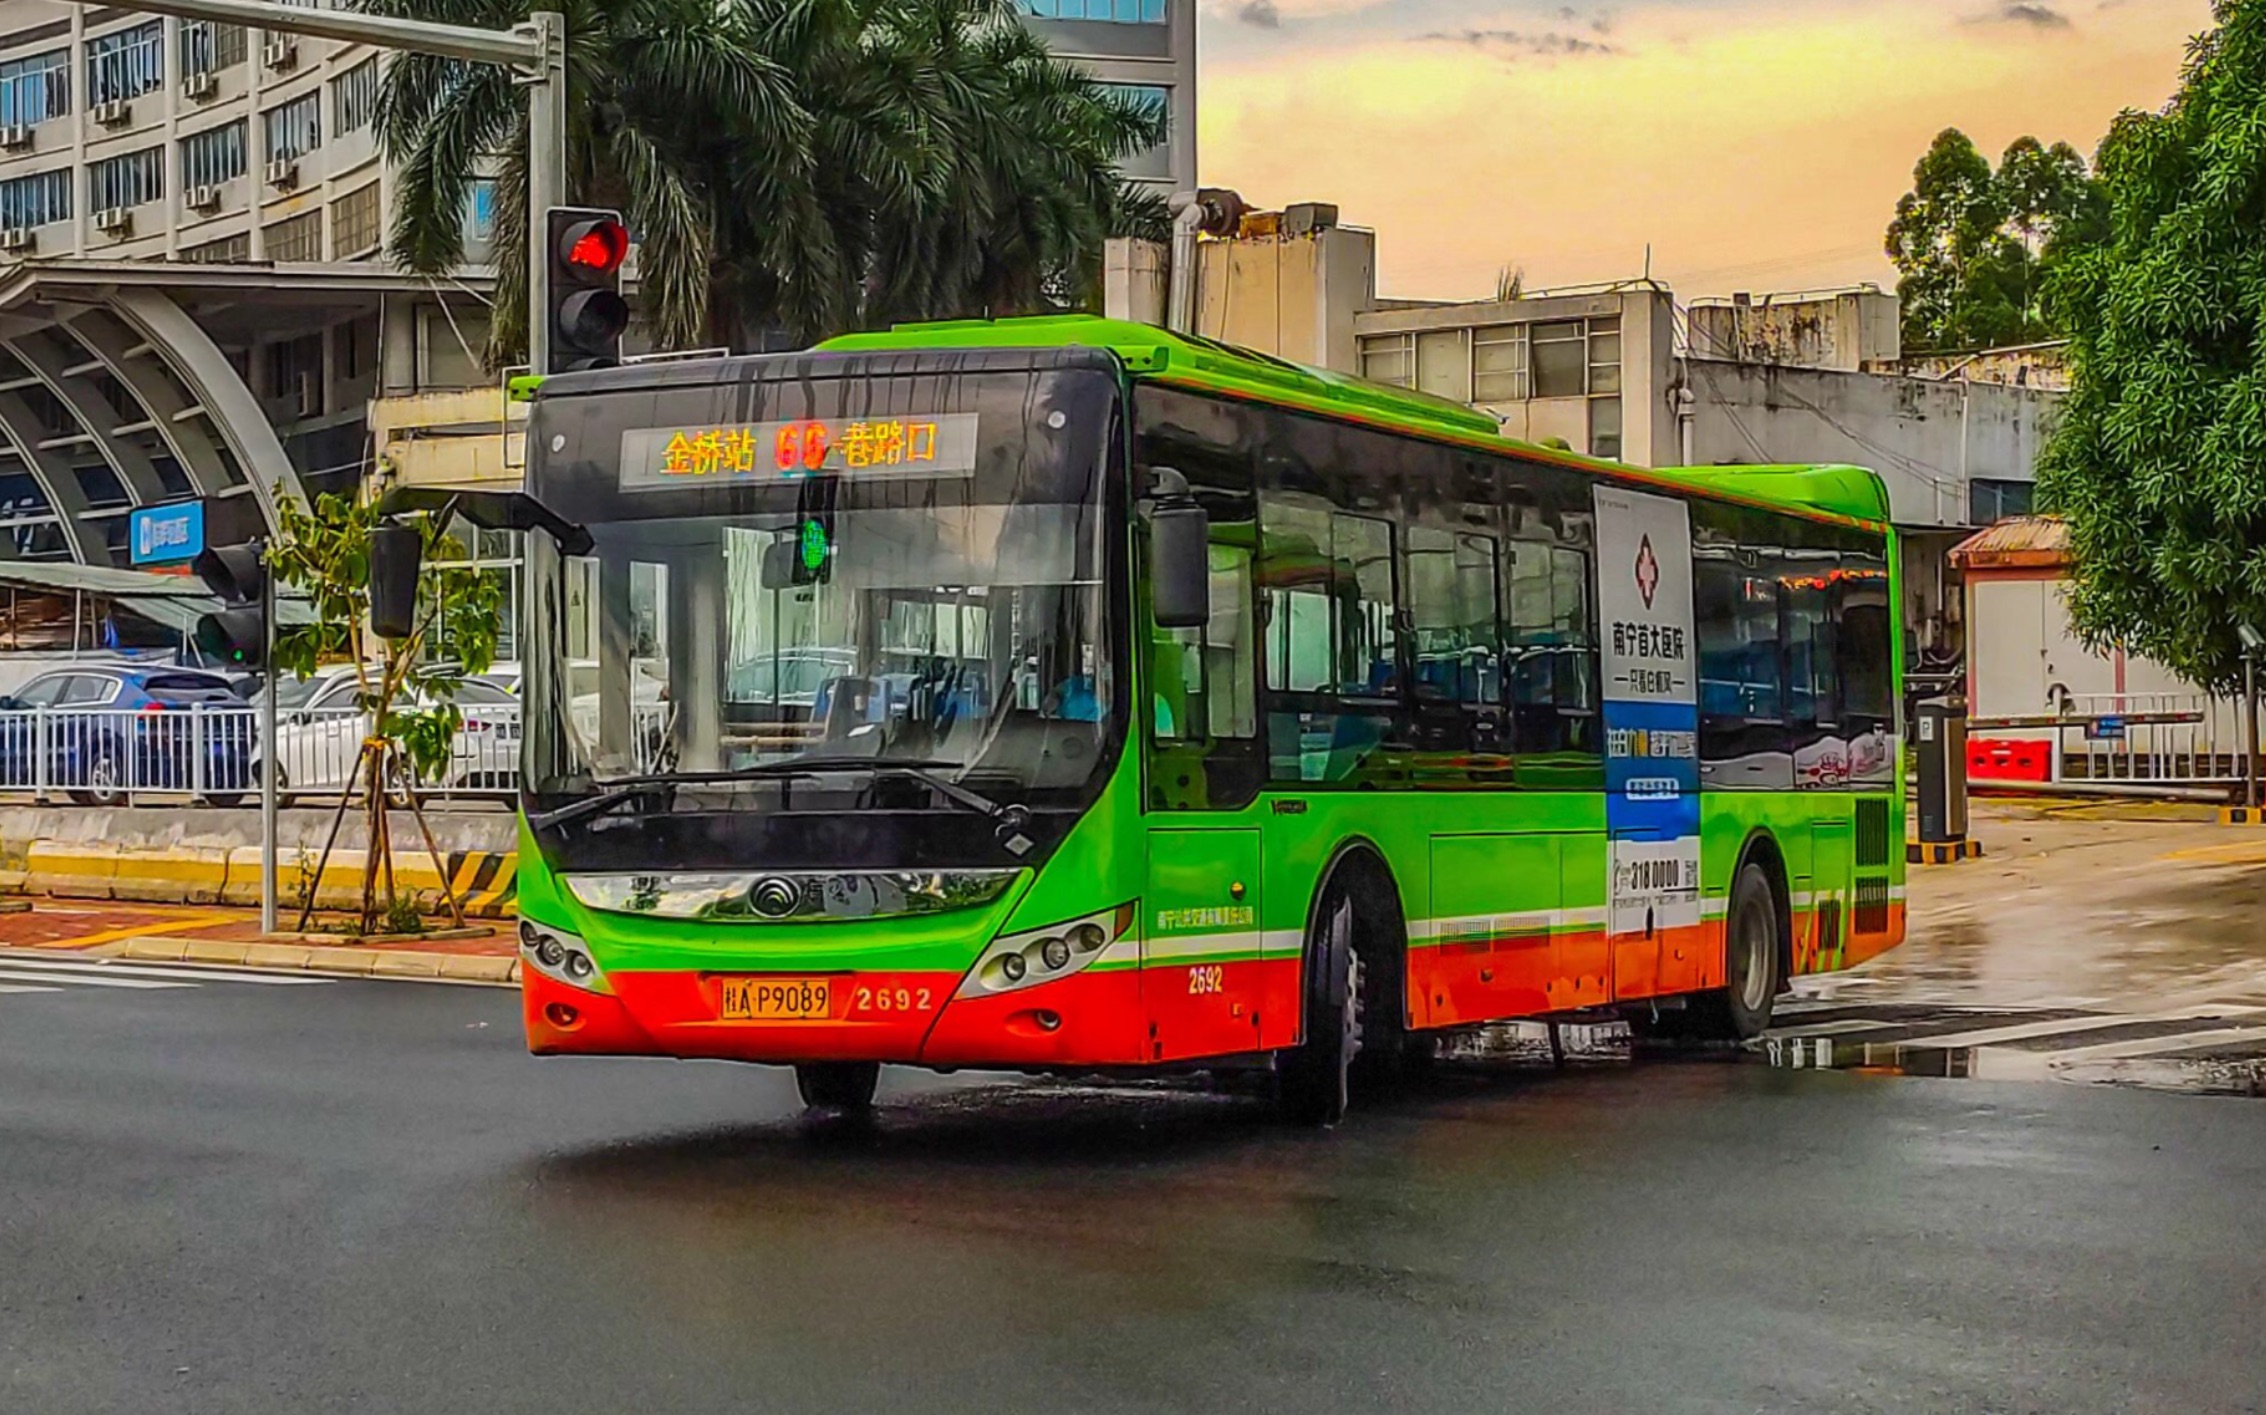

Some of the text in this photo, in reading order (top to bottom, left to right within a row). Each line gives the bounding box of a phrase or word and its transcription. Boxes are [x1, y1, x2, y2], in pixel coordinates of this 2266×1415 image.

[660, 428, 757, 475] 金桥站
[1188, 965, 1223, 995] 2692
[856, 987, 932, 1011] 2692
